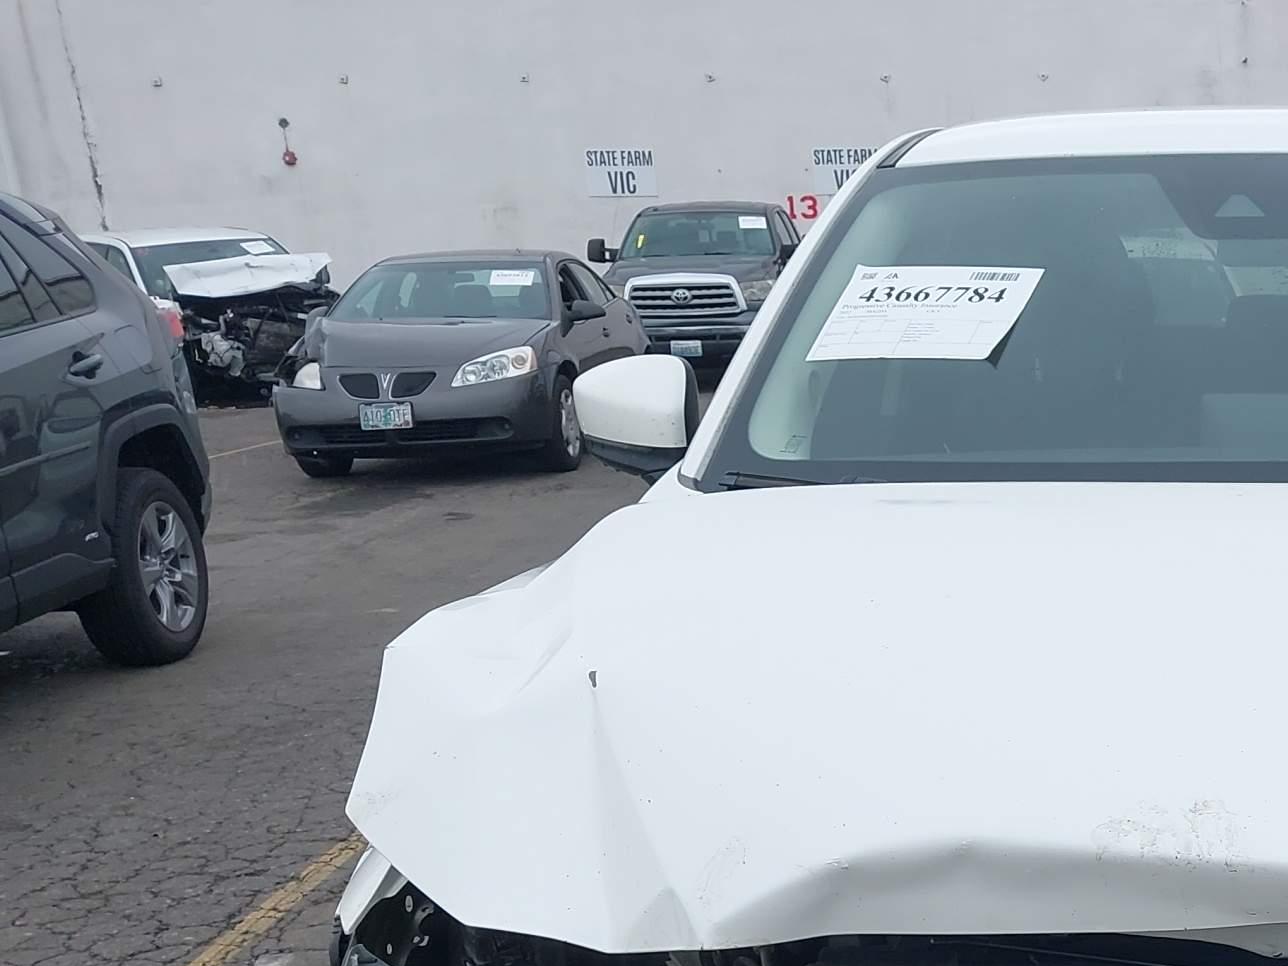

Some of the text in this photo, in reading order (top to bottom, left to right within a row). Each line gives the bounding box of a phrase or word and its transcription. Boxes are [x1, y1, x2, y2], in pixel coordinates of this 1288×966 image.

[586, 150, 653, 167] STATE FARM
[813, 149, 845, 166] STATE
[607, 170, 637, 194] VIC
[786, 195, 818, 219] 13
[859, 285, 1008, 303] 43667784
